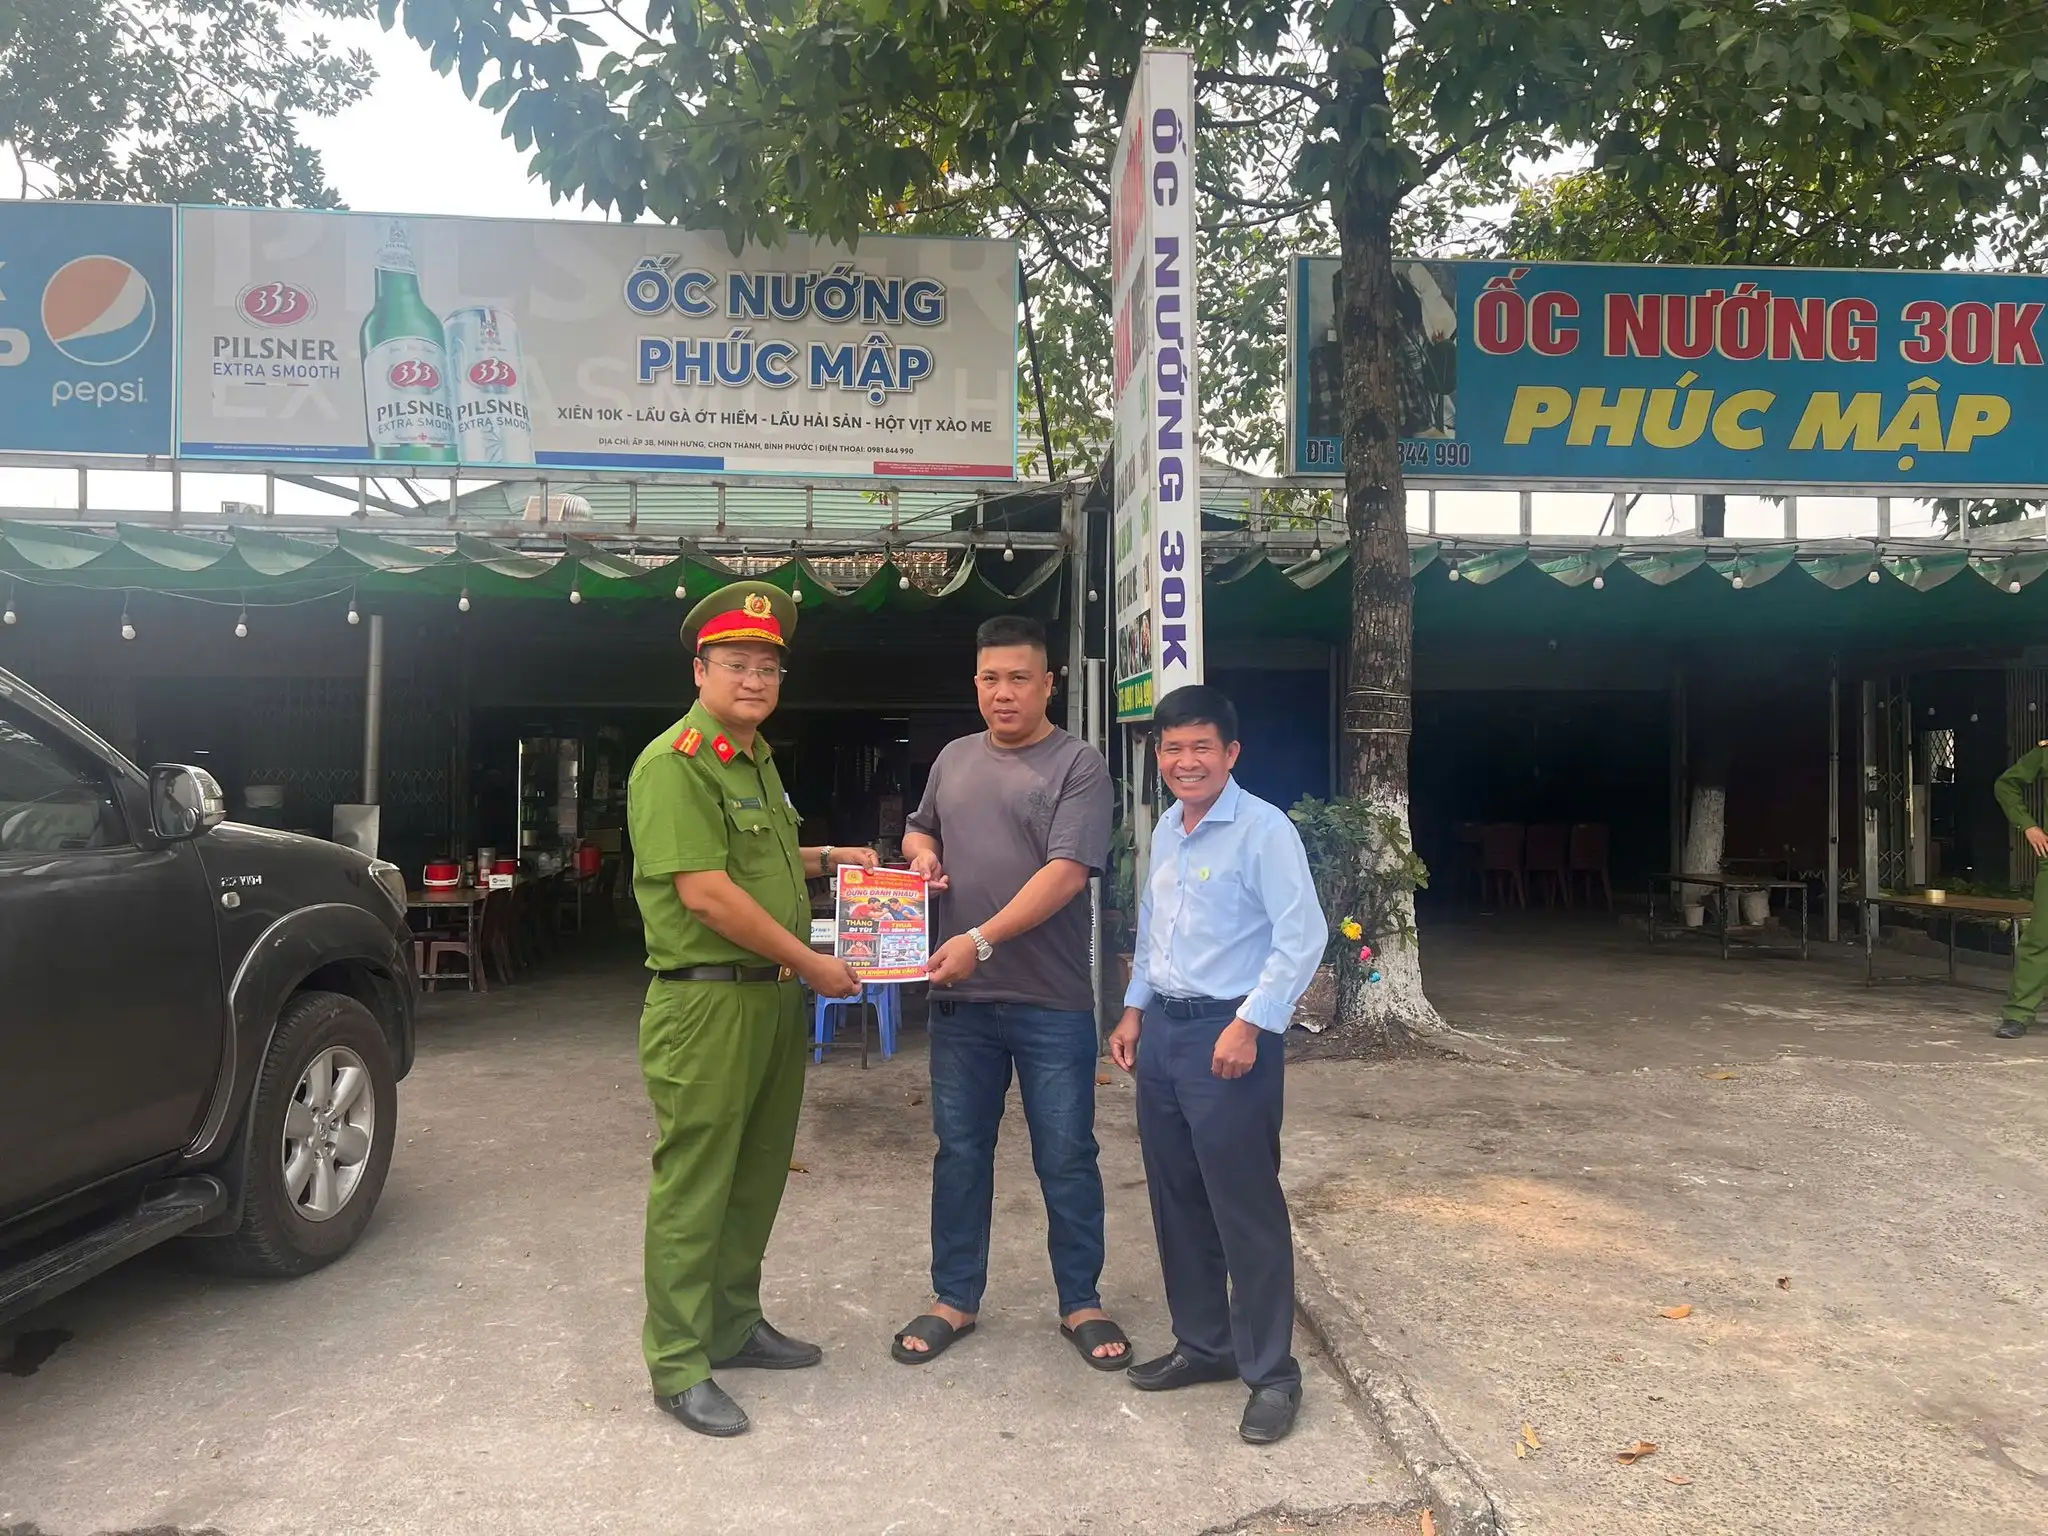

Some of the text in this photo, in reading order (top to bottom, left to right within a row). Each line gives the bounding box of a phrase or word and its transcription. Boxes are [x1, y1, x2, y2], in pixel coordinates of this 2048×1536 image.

[252, 281, 299, 318] 333
[624, 253, 947, 327] ỐC NƯỚNG
[1474, 267, 2046, 365] ỐC NƯỚNG 30K
[213, 336, 338, 361] PILSNER
[213, 362, 340, 379] EXTRA SMOOTH
[399, 358, 431, 384] 333
[478, 358, 508, 383] 333
[636, 326, 934, 406] PHÚC MẬP
[52, 377, 144, 408] pepsi
[1152, 108, 1188, 671] ỐC NƯỚNG 30K
[377, 400, 453, 422] PILSNER
[457, 399, 530, 421] PILSNER
[557, 405, 593, 420] XIÊN
[597, 409, 623, 421] 10K
[670, 408, 690, 423] GÀ
[695, 408, 716, 424] ỚT
[804, 412, 829, 428] HẢI
[832, 413, 862, 429] SẢN
[875, 415, 905, 433] HỘT
[910, 418, 933, 435] VỊT
[936, 416, 967, 432] XÀO
[971, 420, 992, 433] ME
[1503, 370, 2012, 472] PHÚC MẬP
[378, 416, 413, 435] EXTRA
[459, 417, 493, 433] EXTRA
[658, 439, 679, 448] MINH
[867, 446, 884, 455] 0981
[885, 447, 898, 455] 844
[900, 447, 914, 455] 990
[1306, 440, 1335, 464] ĐT:
[1435, 442, 1471, 467] 990
